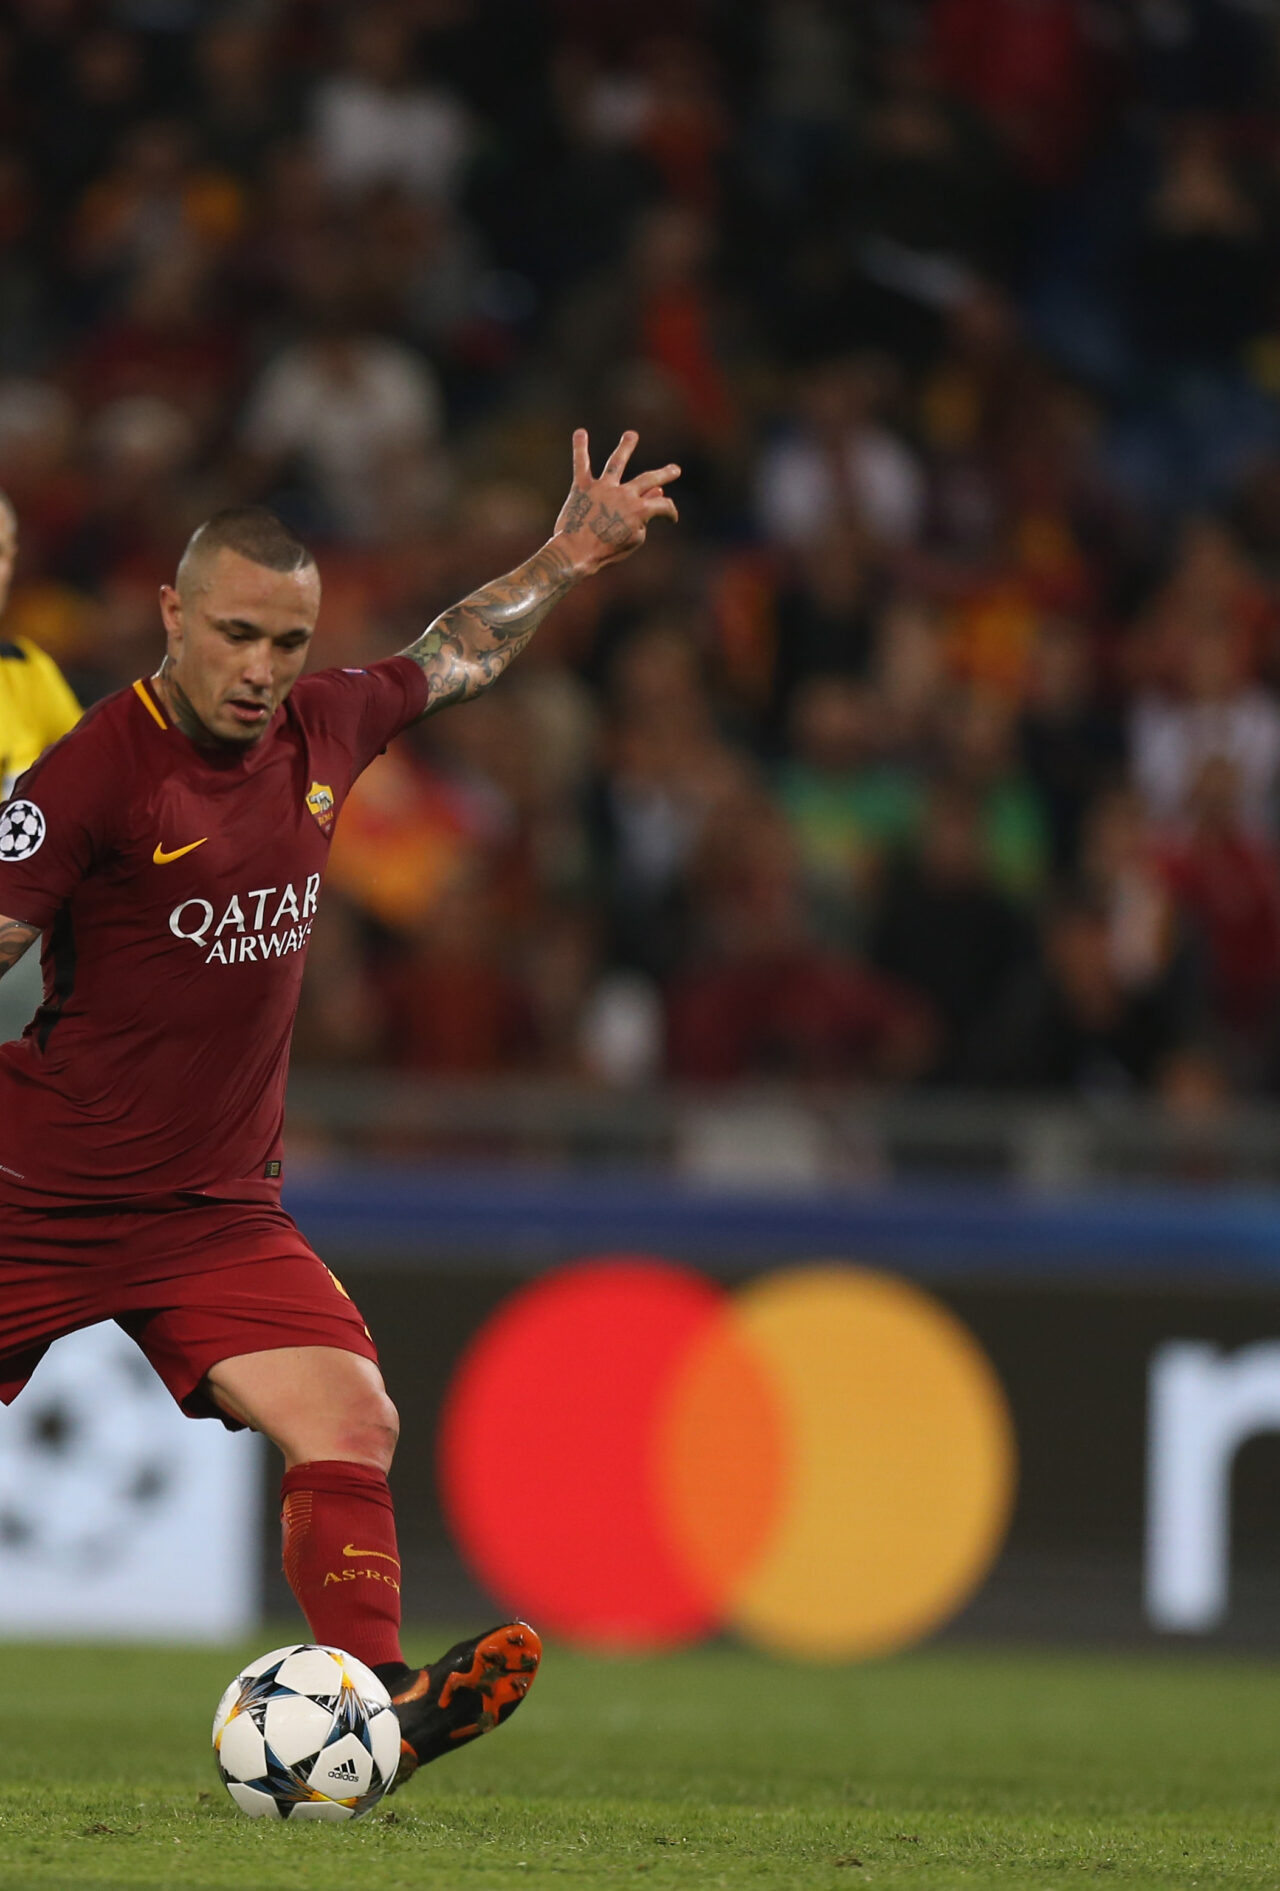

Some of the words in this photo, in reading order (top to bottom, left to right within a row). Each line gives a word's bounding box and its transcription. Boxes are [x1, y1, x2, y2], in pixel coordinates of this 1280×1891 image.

[169, 872, 320, 947] QATAR
[323, 1568, 400, 1596] AS-RO
[328, 1770, 359, 1782] adidas
